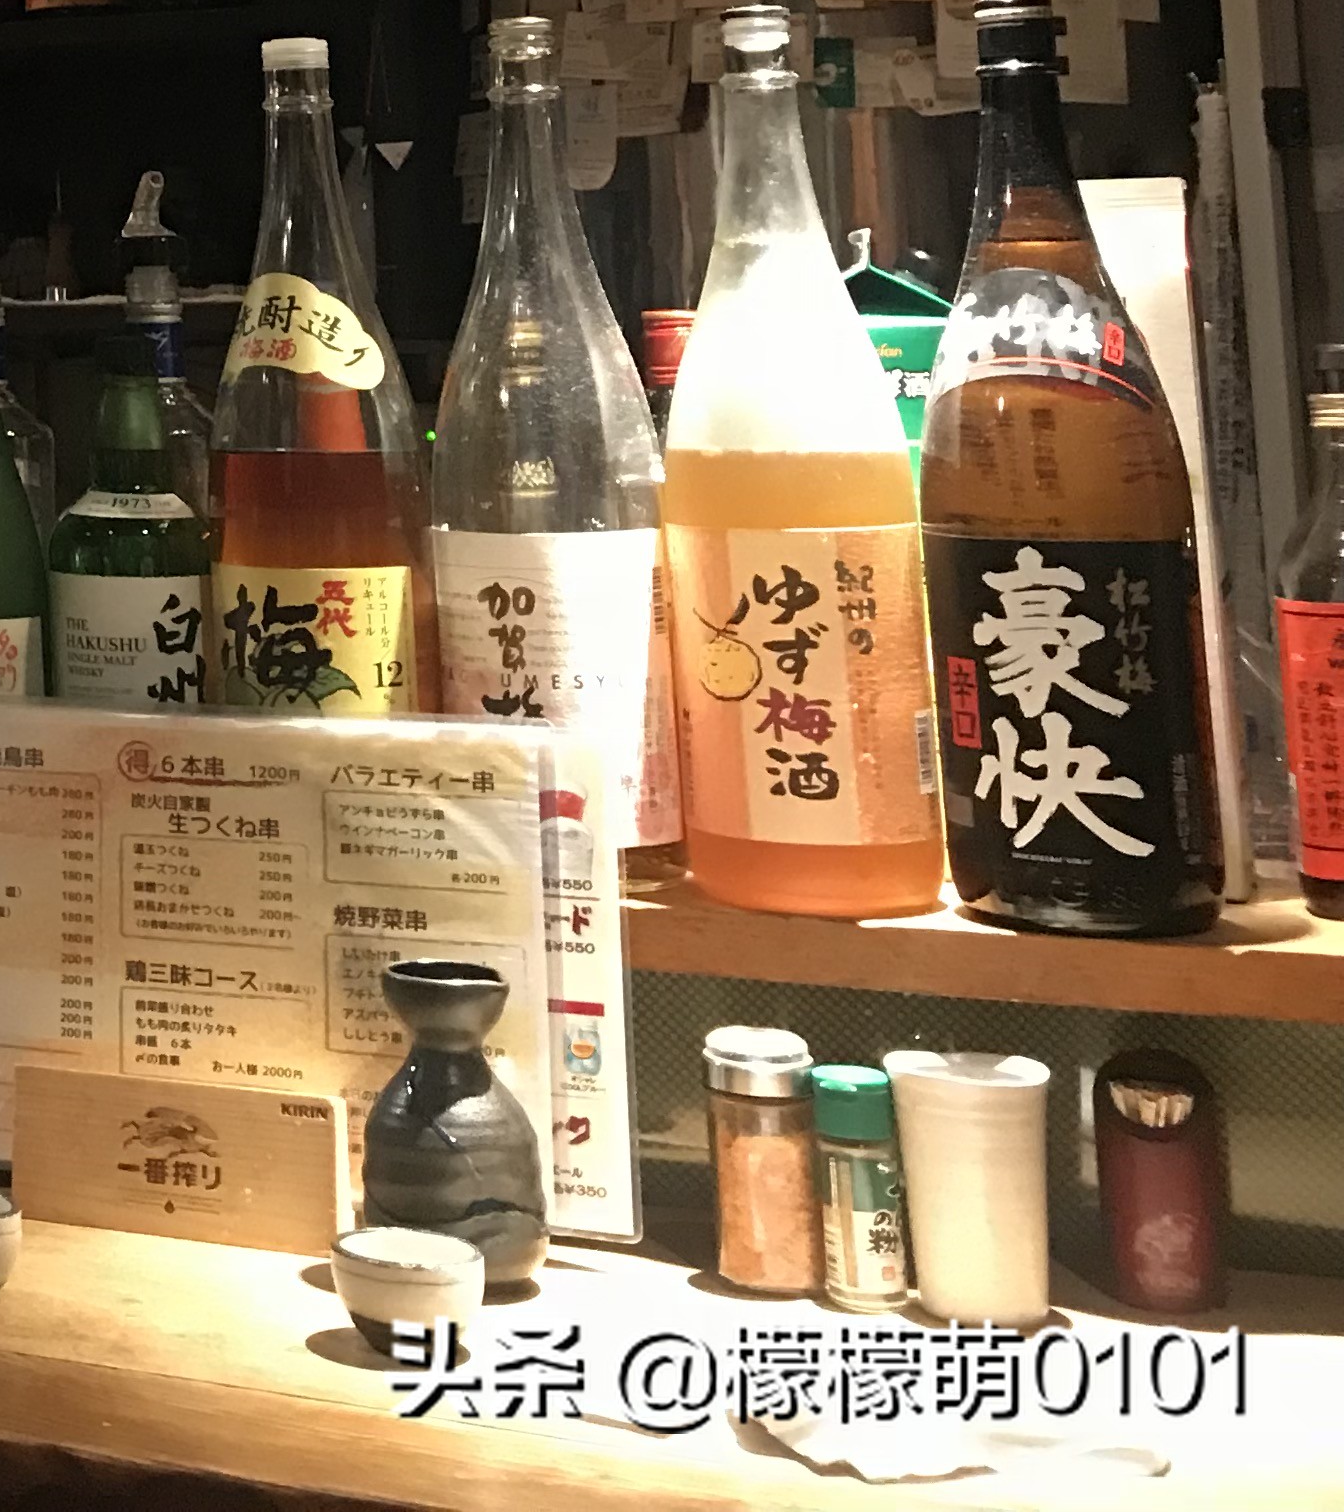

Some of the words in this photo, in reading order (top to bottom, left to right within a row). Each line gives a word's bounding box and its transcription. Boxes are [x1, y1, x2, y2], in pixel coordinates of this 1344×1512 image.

[111, 497, 153, 509] 1973
[315, 579, 358, 638] 五代
[362, 576, 376, 638] リキュール
[66, 617, 89, 632] THE
[1106, 566, 1158, 696] 松竹梅
[66, 634, 147, 655] HAKUSHU
[147, 593, 207, 704] 白州
[223, 583, 333, 703] 梅
[102, 654, 138, 666] MALT
[752, 564, 840, 801] ゆず梅酒
[952, 665, 978, 739] 辛口
[973, 544, 1157, 858] 豪快
[161, 755, 225, 776] 6本串
[249, 765, 301, 781] 1200円
[330, 763, 495, 793] バラエティー串
[131, 793, 211, 813] 炭火自家製
[168, 813, 280, 839] 生つくね串
[259, 851, 293, 864] 250円
[259, 870, 293, 883] 250円
[259, 890, 294, 902] 200円
[334, 904, 428, 931] 焼野菜串
[61, 974, 94, 987] 200円
[60, 998, 94, 1011] 200円
[60, 1013, 94, 1025] 200円
[60, 1027, 94, 1039] 200円
[262, 1065, 304, 1079] 2000円
[280, 1102, 329, 1120] KIRIN
[117, 1157, 223, 1191] 一番搾り
